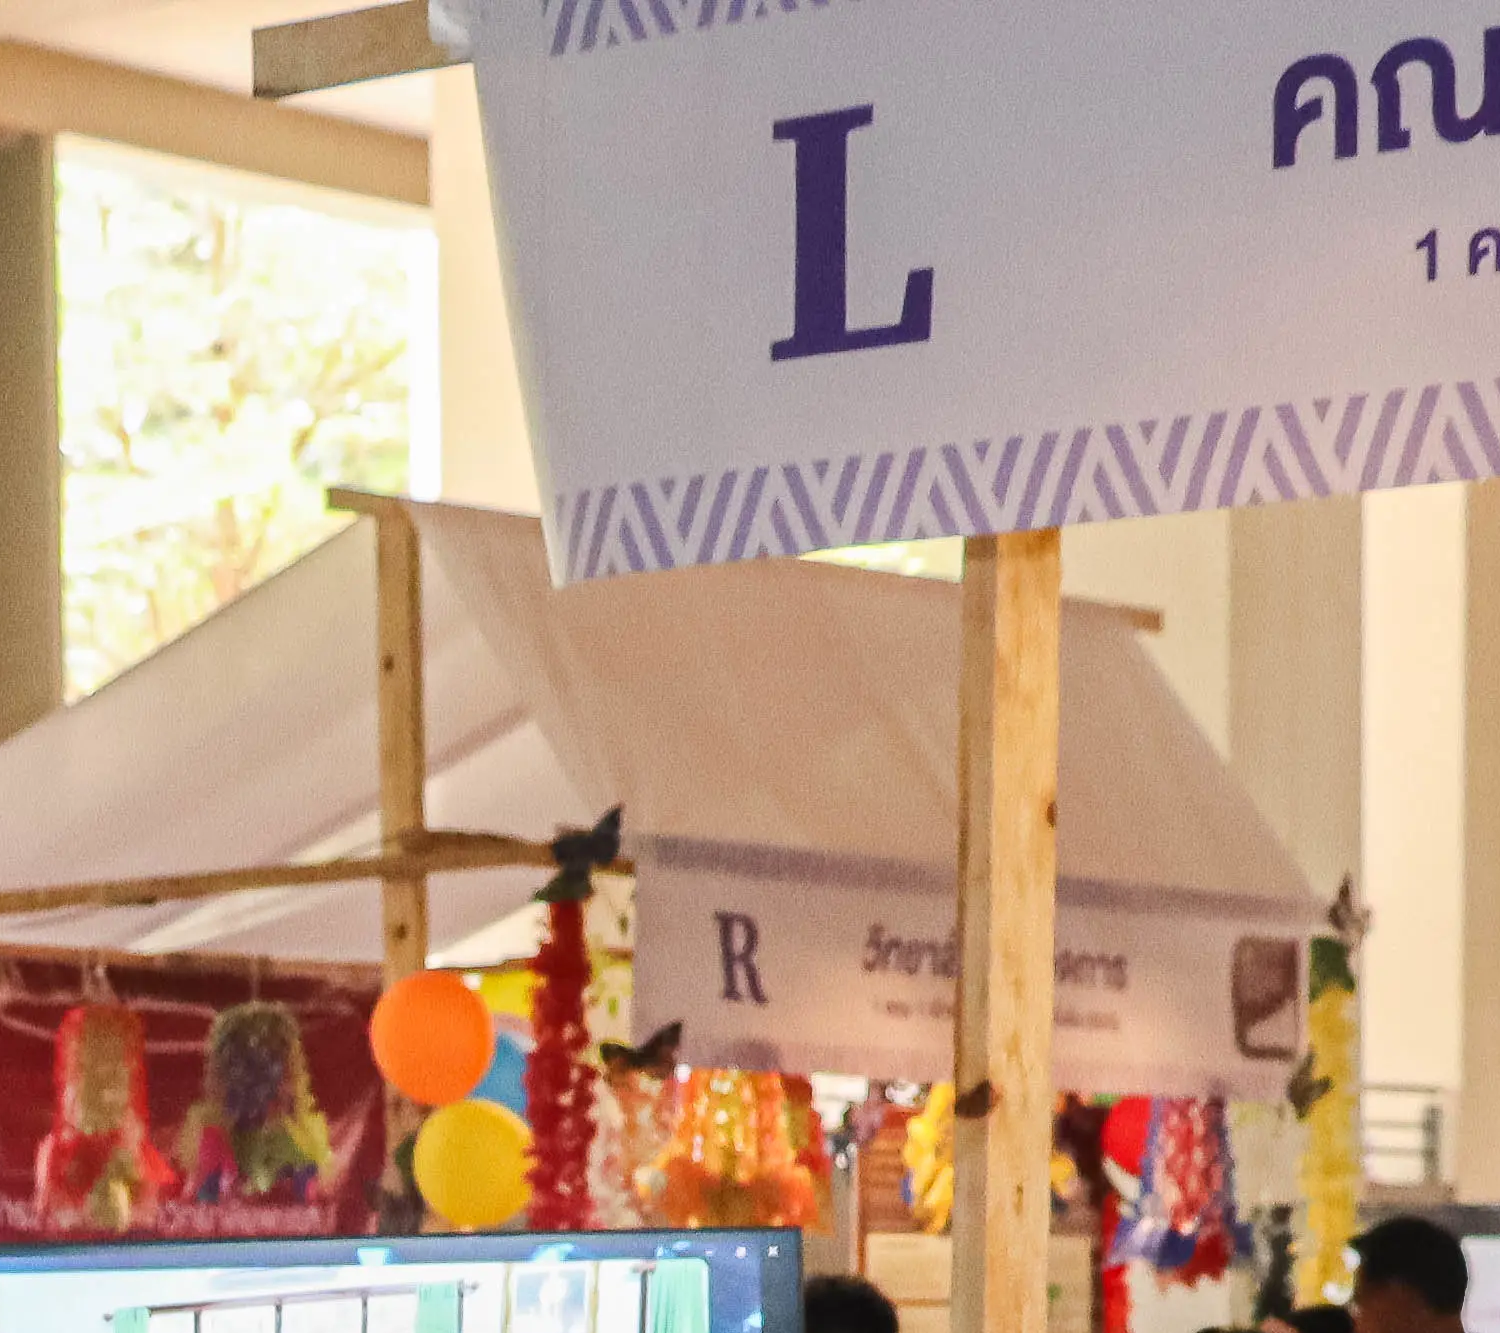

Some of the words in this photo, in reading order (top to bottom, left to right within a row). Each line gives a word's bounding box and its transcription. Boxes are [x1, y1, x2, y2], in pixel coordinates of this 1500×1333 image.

[771, 105, 933, 361] L
[1414, 229, 1438, 281] 1
[715, 911, 768, 1005] R
